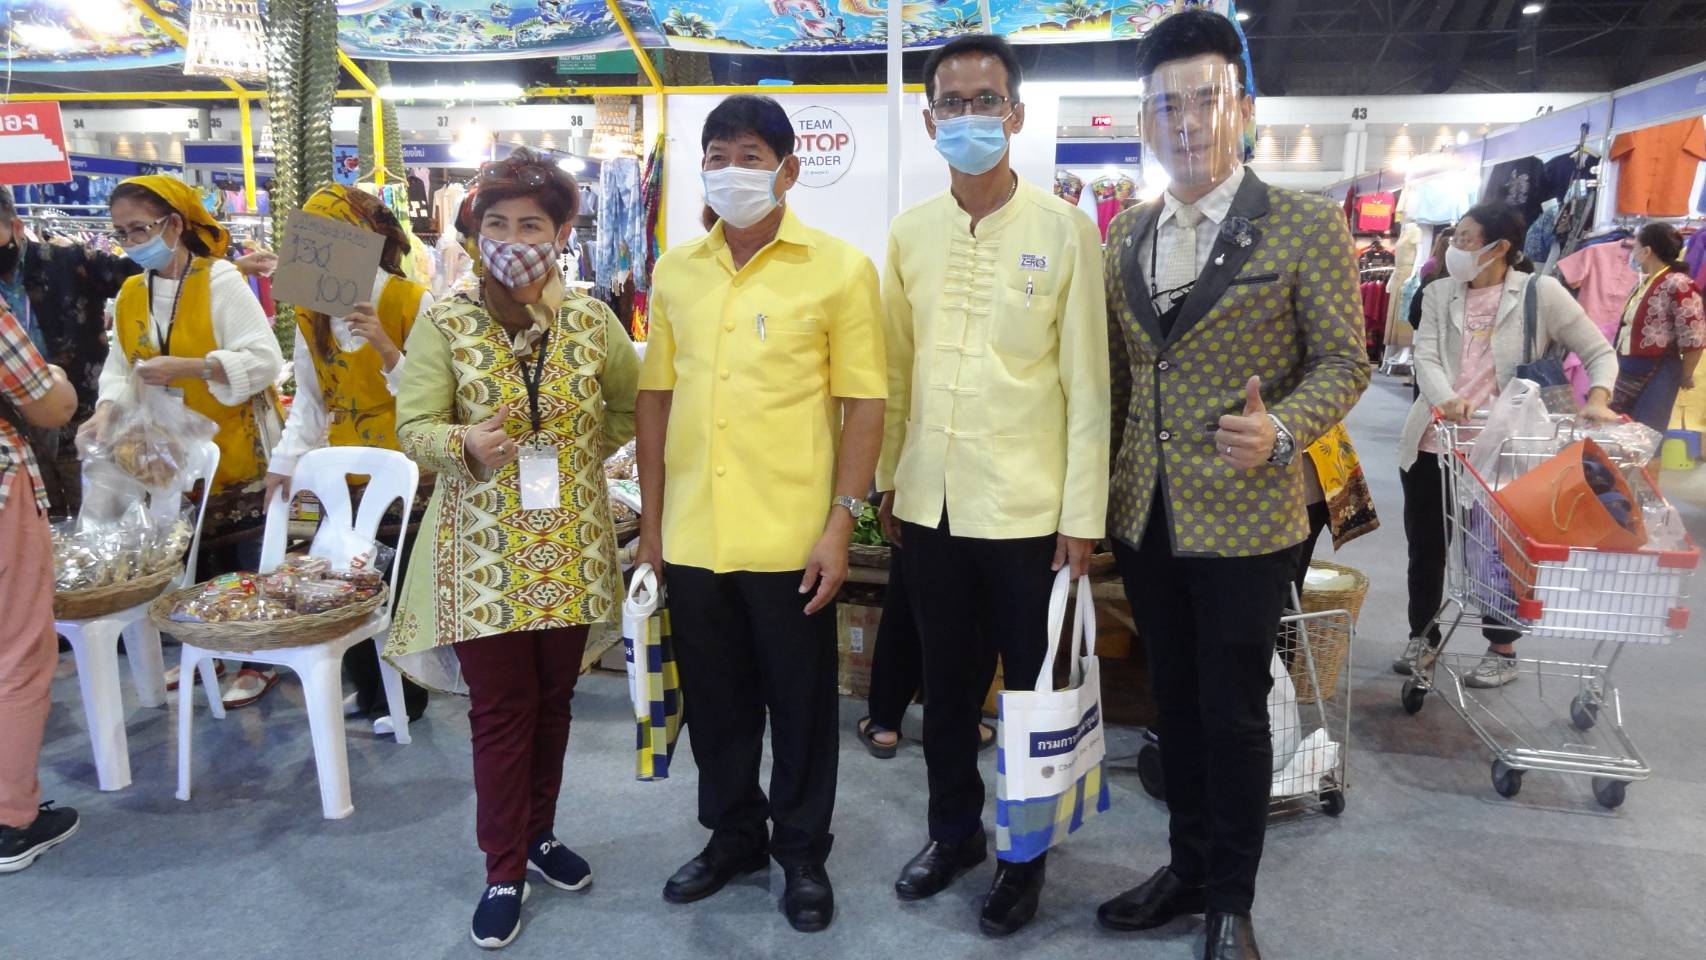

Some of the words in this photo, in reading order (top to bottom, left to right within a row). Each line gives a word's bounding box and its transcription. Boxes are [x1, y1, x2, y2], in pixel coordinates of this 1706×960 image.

[1351, 107, 1368, 120] 43
[0, 113, 39, 131] อง
[73, 119, 85, 130] 34
[188, 118, 199, 129] 35
[210, 118, 222, 129] 35
[437, 116, 449, 127] 37
[571, 115, 583, 126] 38
[798, 119, 833, 130] TEAM
[799, 155, 841, 166] RADER
[315, 273, 358, 306] 100
